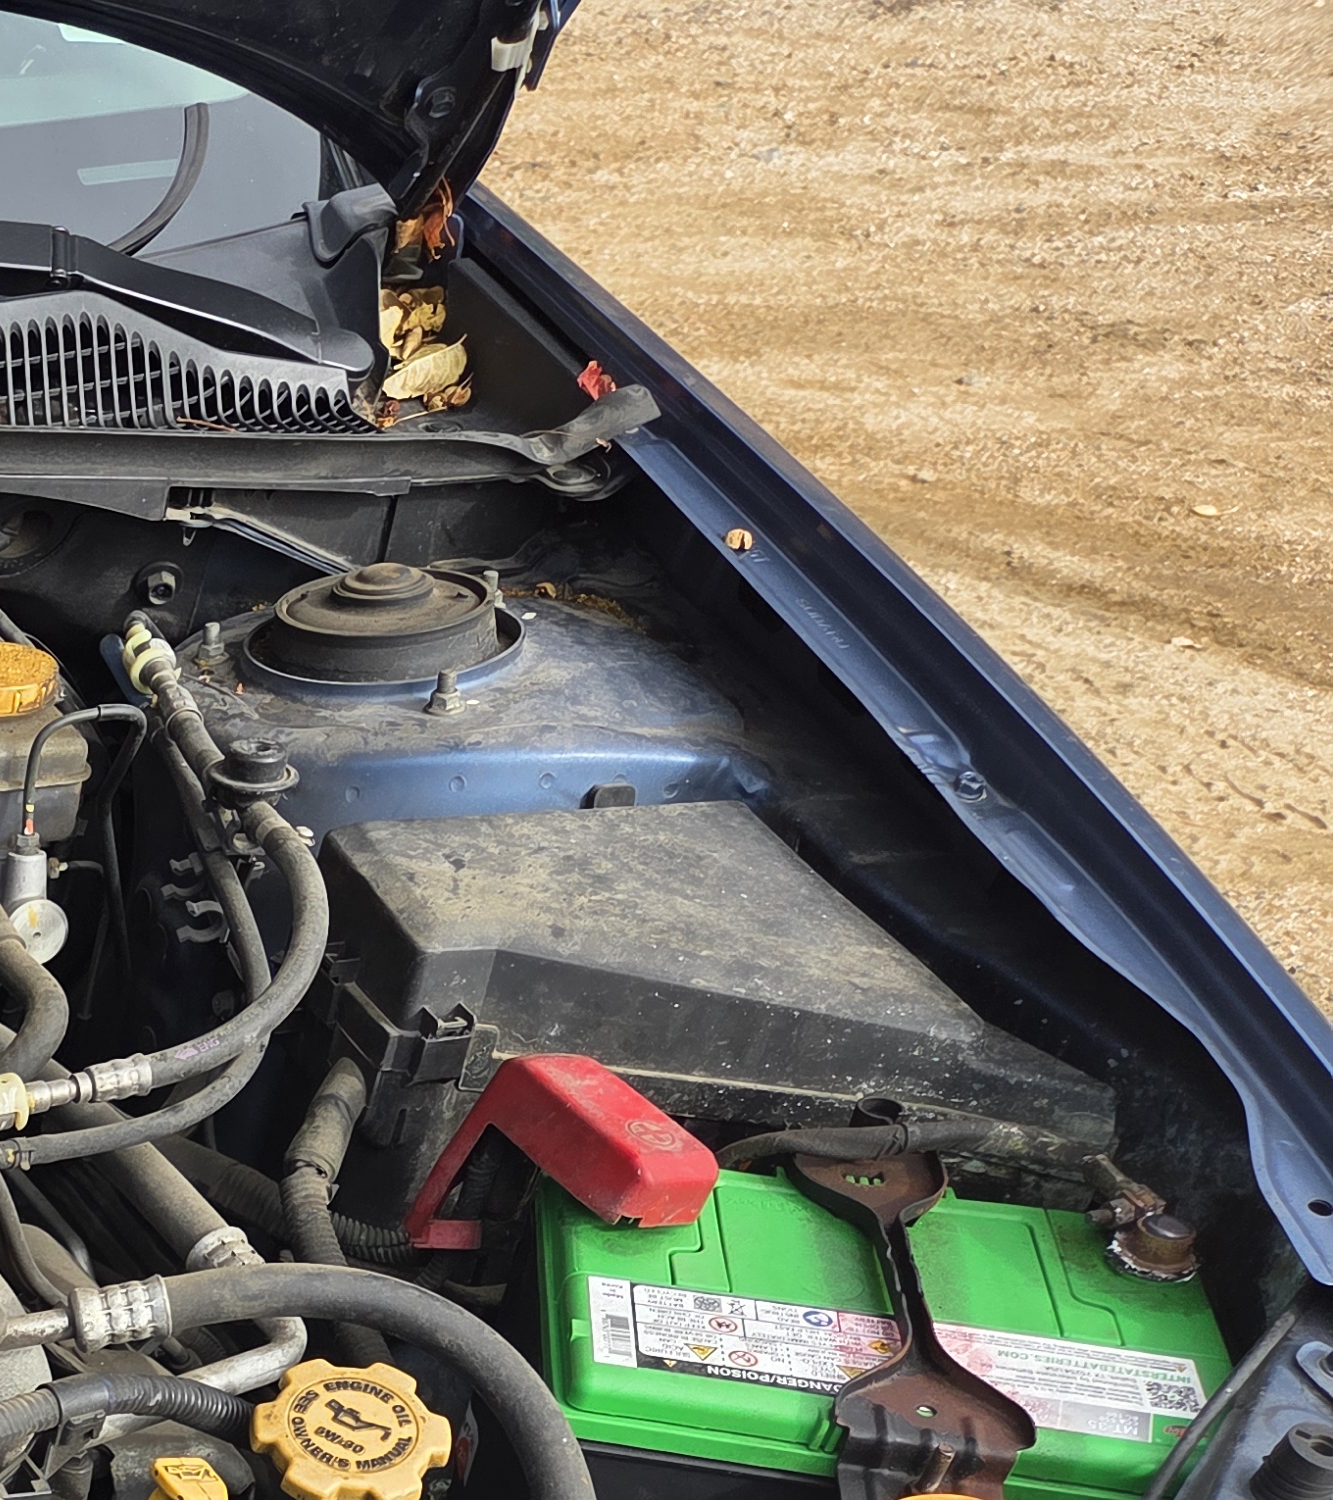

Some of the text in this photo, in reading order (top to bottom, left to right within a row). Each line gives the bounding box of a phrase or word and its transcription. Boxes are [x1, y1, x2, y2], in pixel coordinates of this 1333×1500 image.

[995, 1348, 1192, 1383] INTERSTATEBATTERIES.COM
[323, 1380, 412, 1428] ENGINE OIL
[291, 1389, 413, 1471] SEE OWNER'S MANUAL
[1086, 1419, 1139, 1435] MT-35
